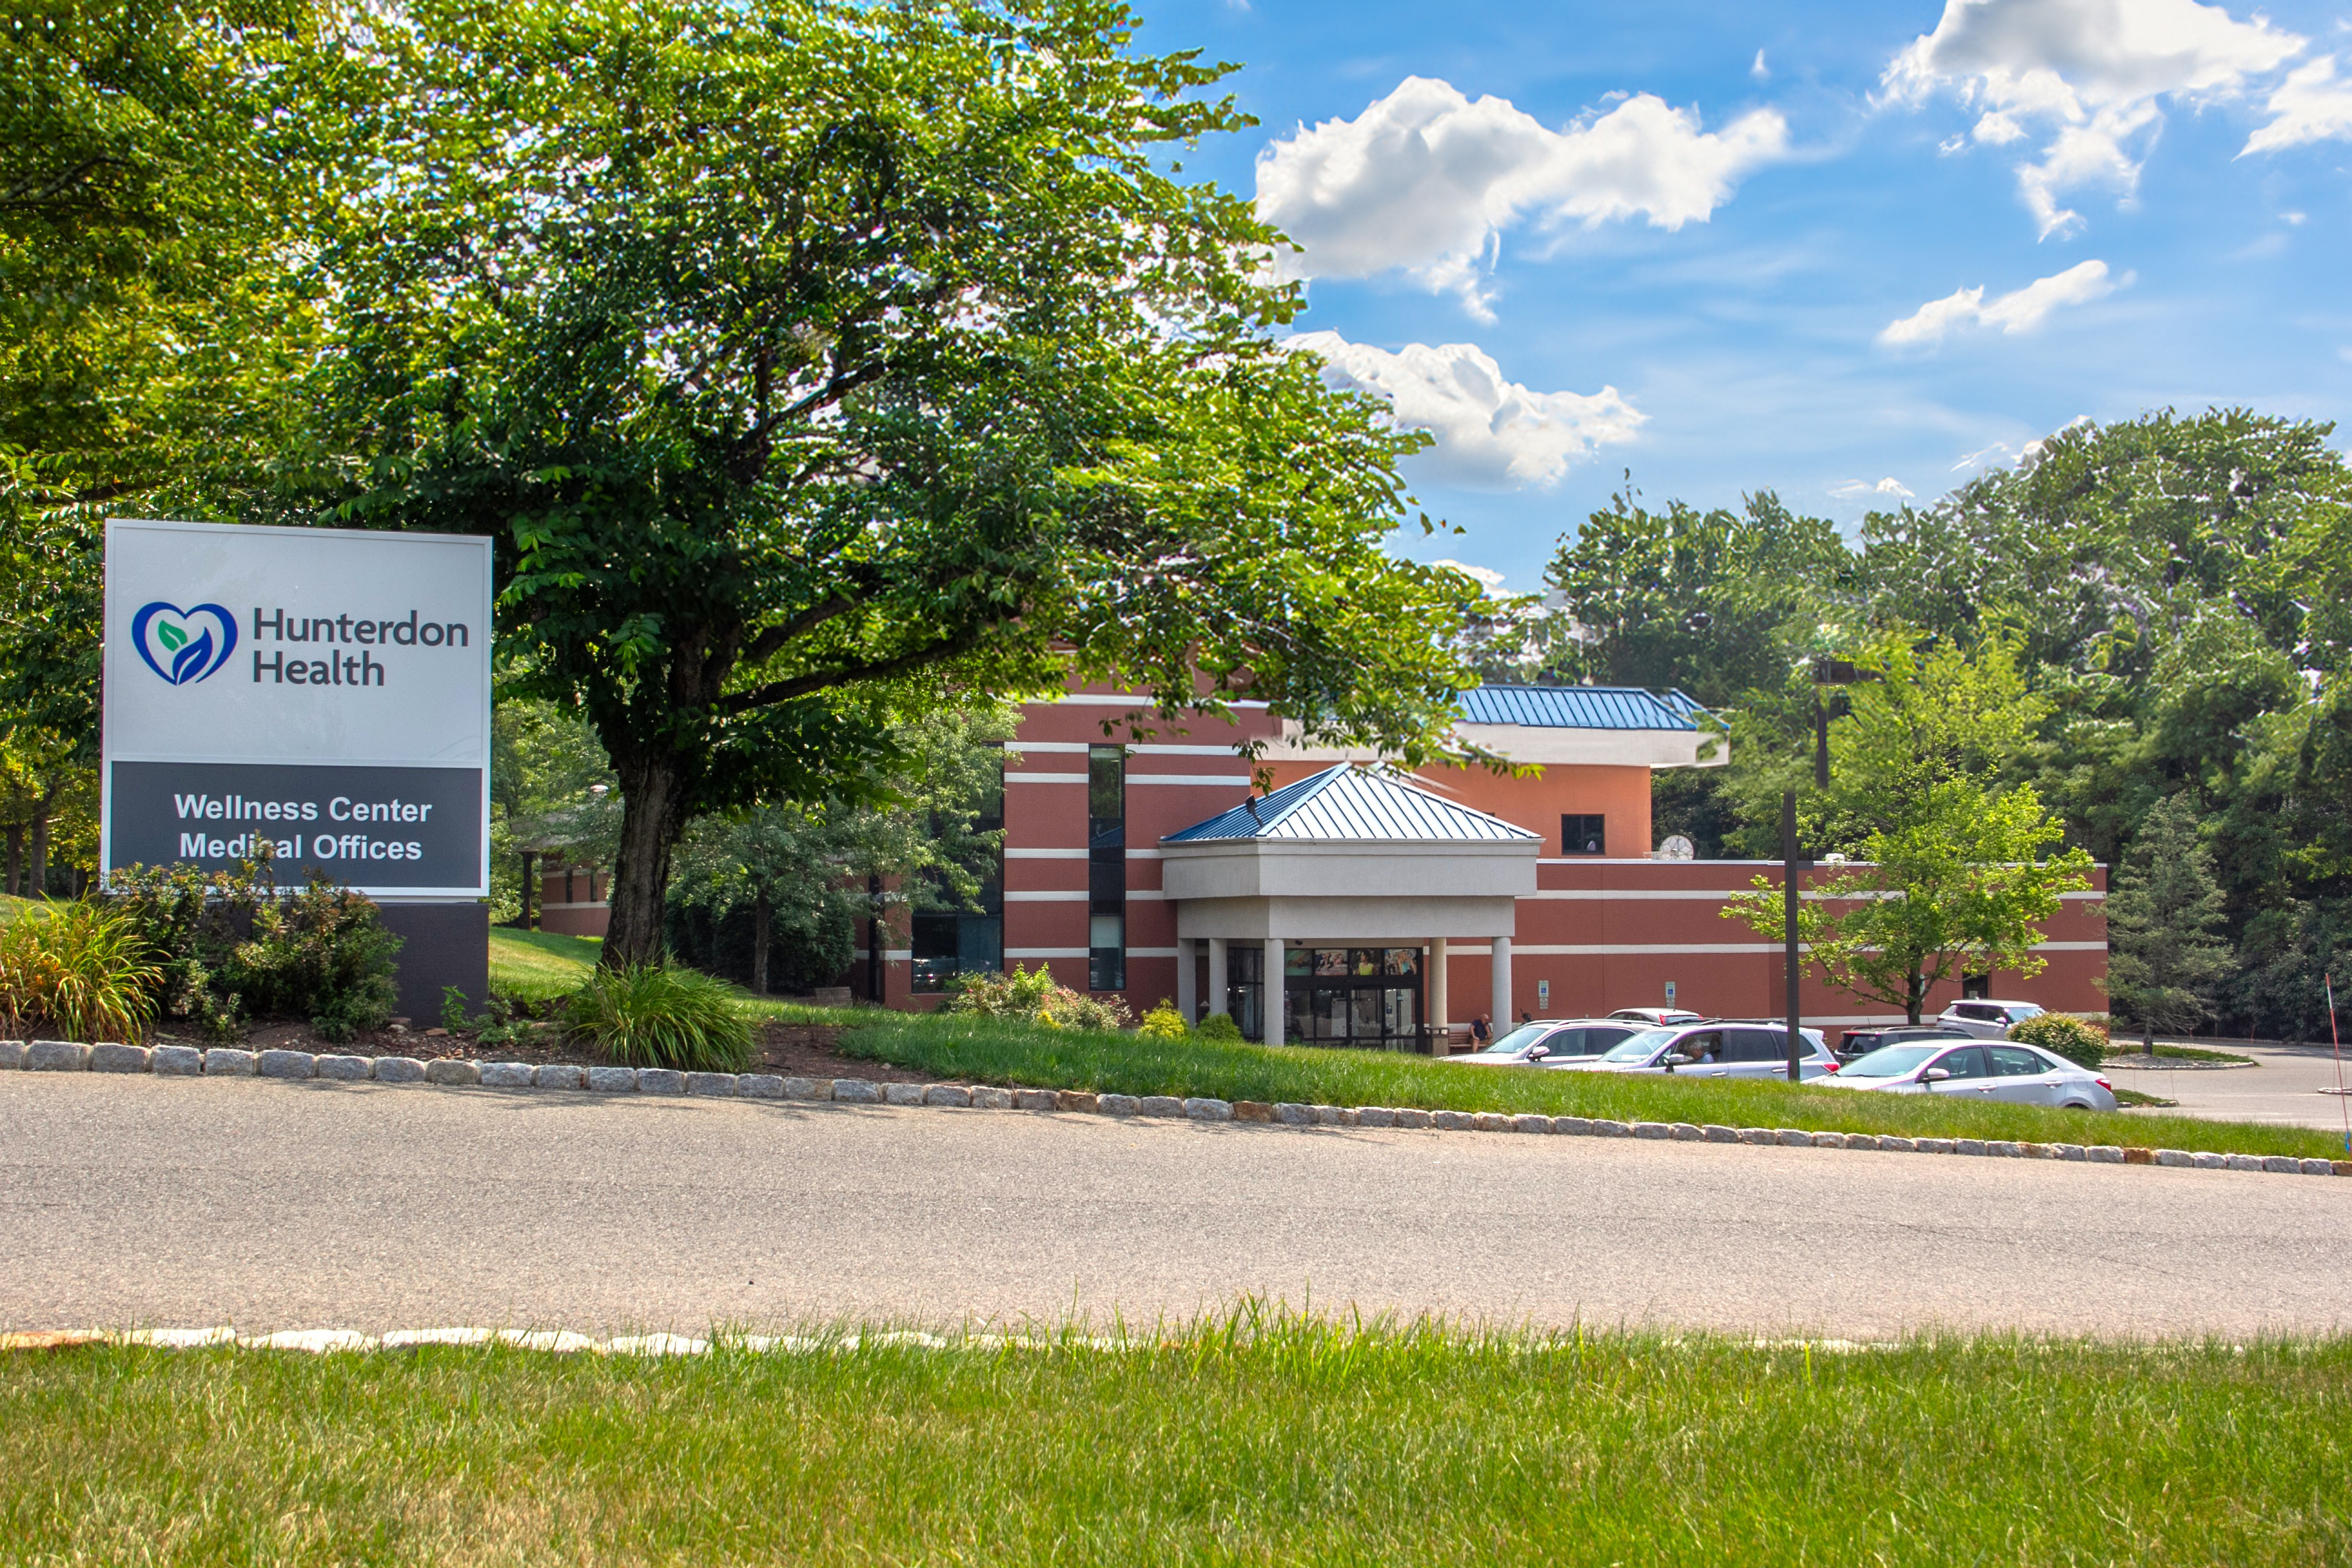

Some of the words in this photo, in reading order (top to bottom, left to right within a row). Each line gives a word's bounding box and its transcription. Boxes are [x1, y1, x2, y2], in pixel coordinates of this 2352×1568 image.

[253, 607, 469, 647] Hunterdon
[253, 649, 384, 686] Health
[174, 794, 318, 821] Wellness
[329, 796, 433, 822] Center
[180, 832, 302, 859] Medial
[313, 834, 422, 860] Offices
